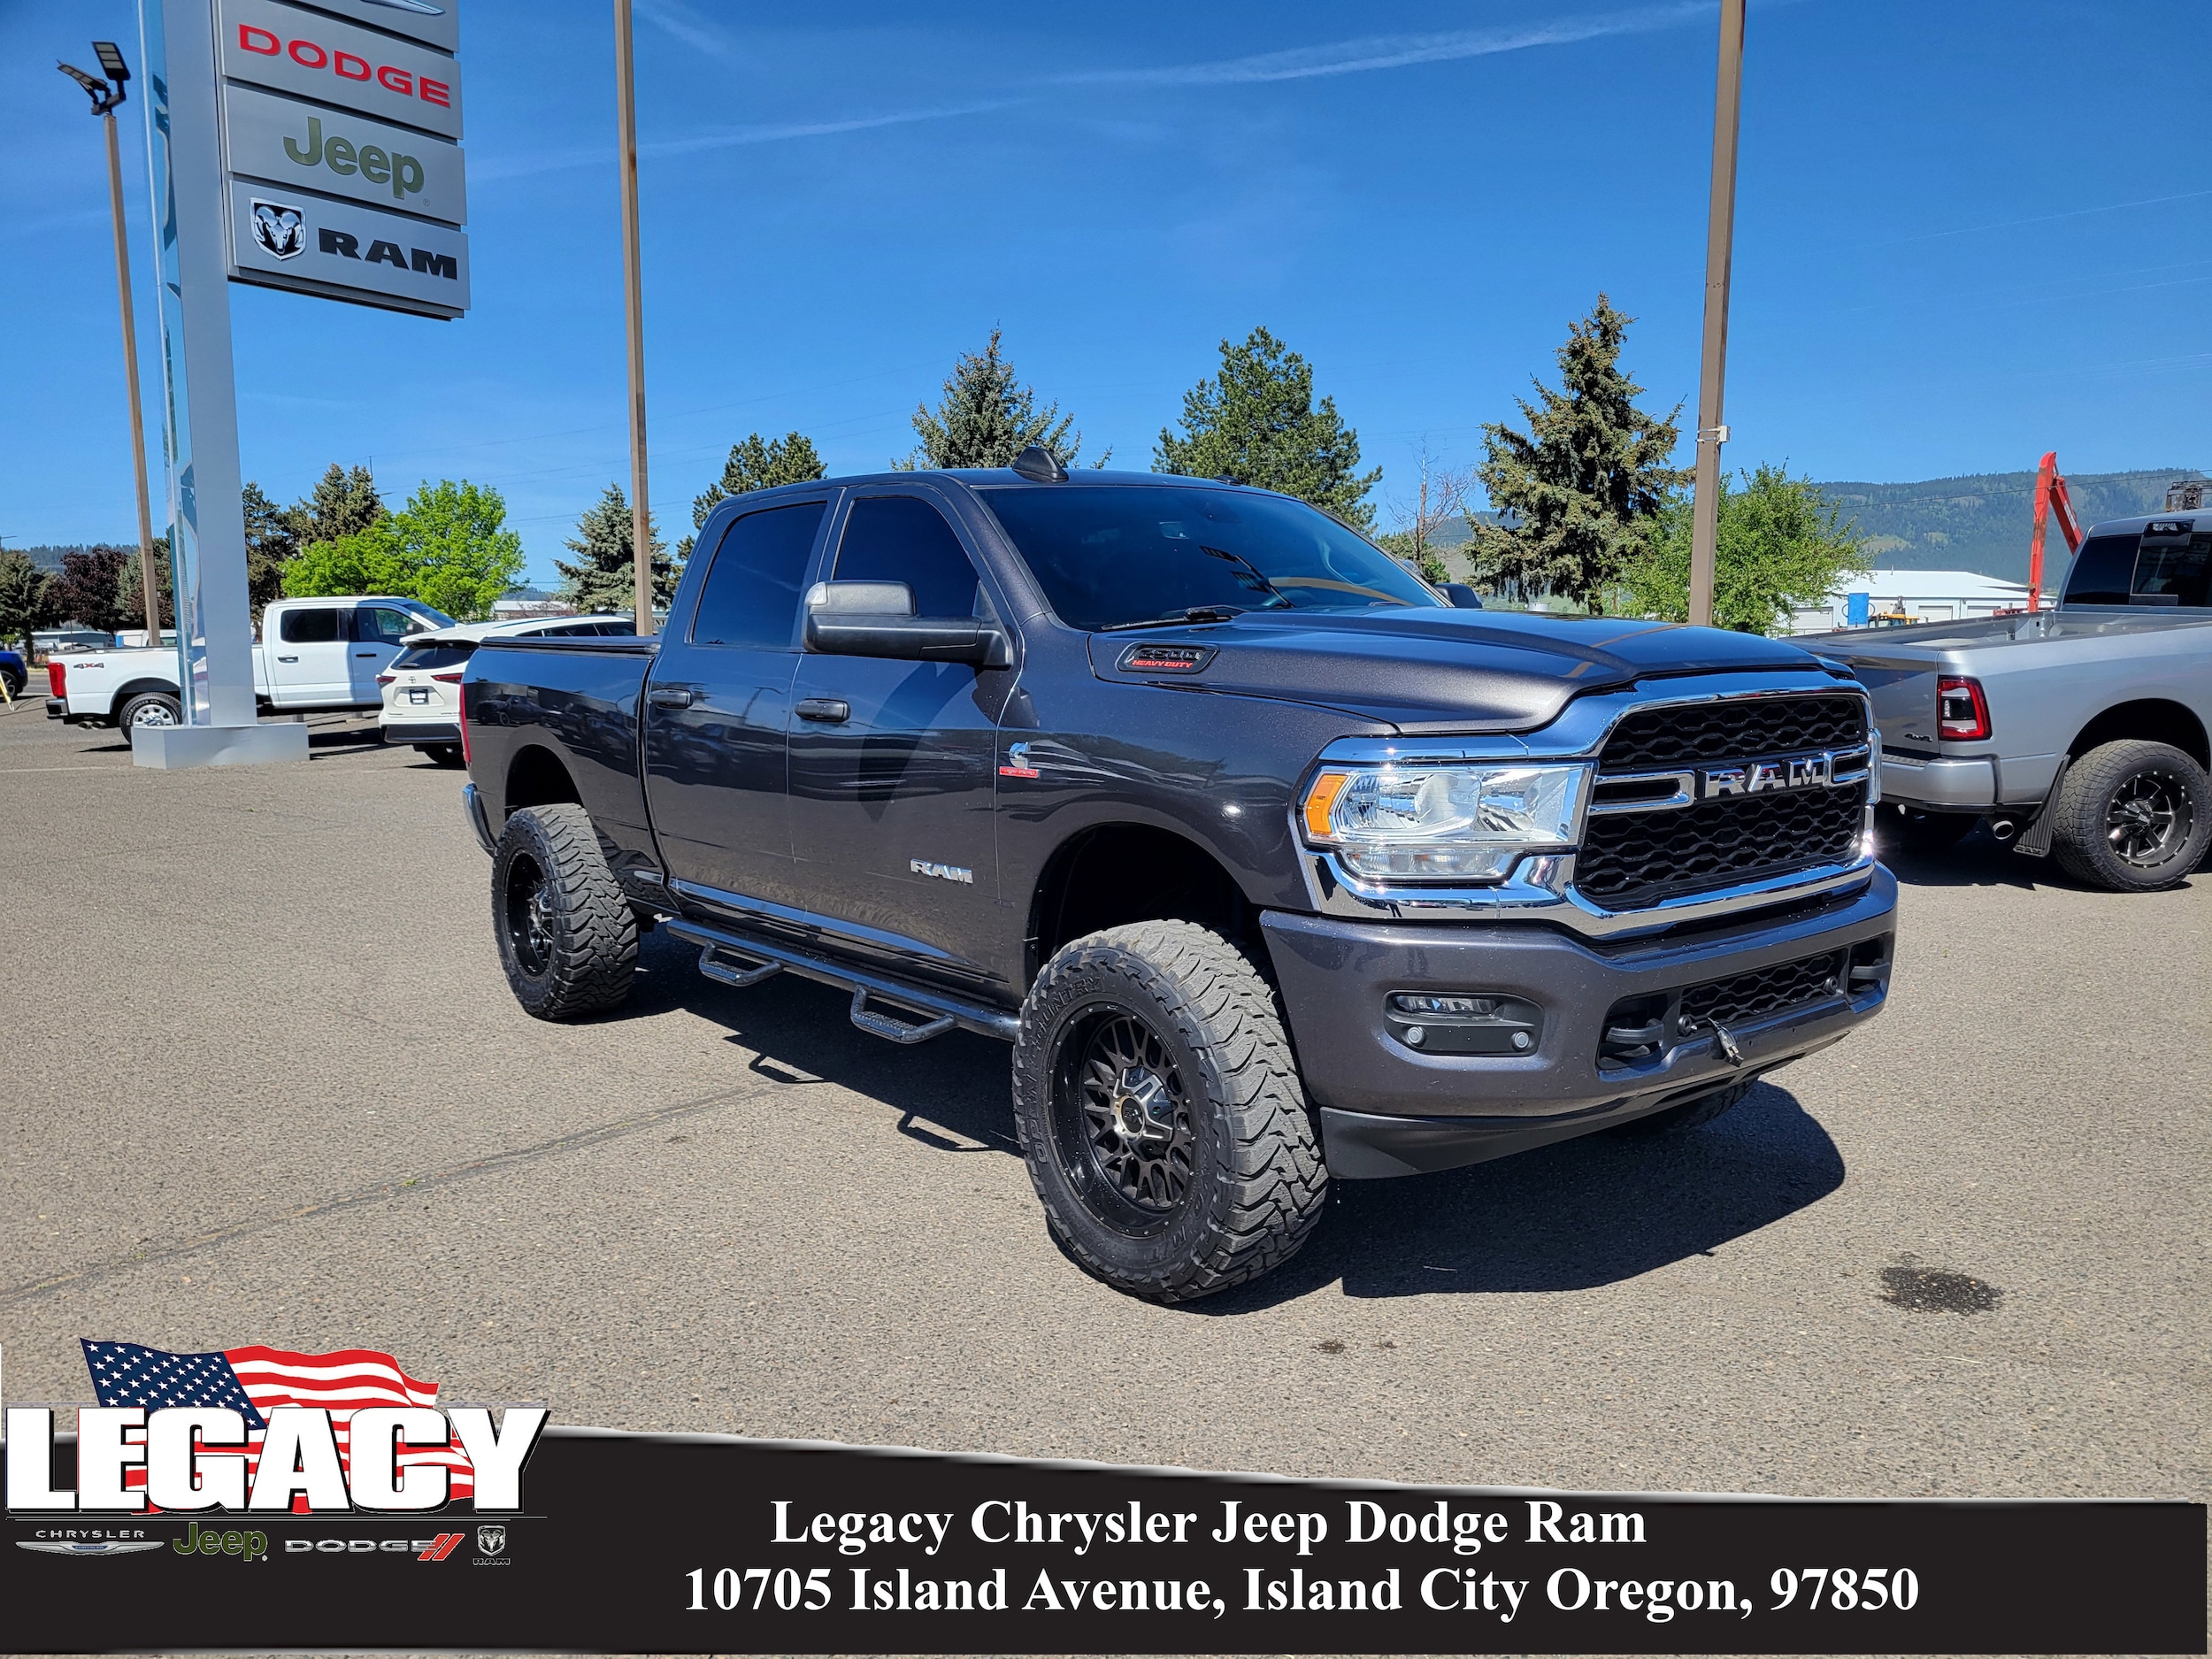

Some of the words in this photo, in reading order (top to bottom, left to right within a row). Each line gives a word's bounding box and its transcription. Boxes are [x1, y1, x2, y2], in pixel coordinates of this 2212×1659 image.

[239, 24, 450, 108] DODGE
[283, 116, 425, 199] Jeep
[319, 227, 457, 280] RAM
[1699, 757, 1824, 798] RAM
[910, 858, 973, 884] RAM
